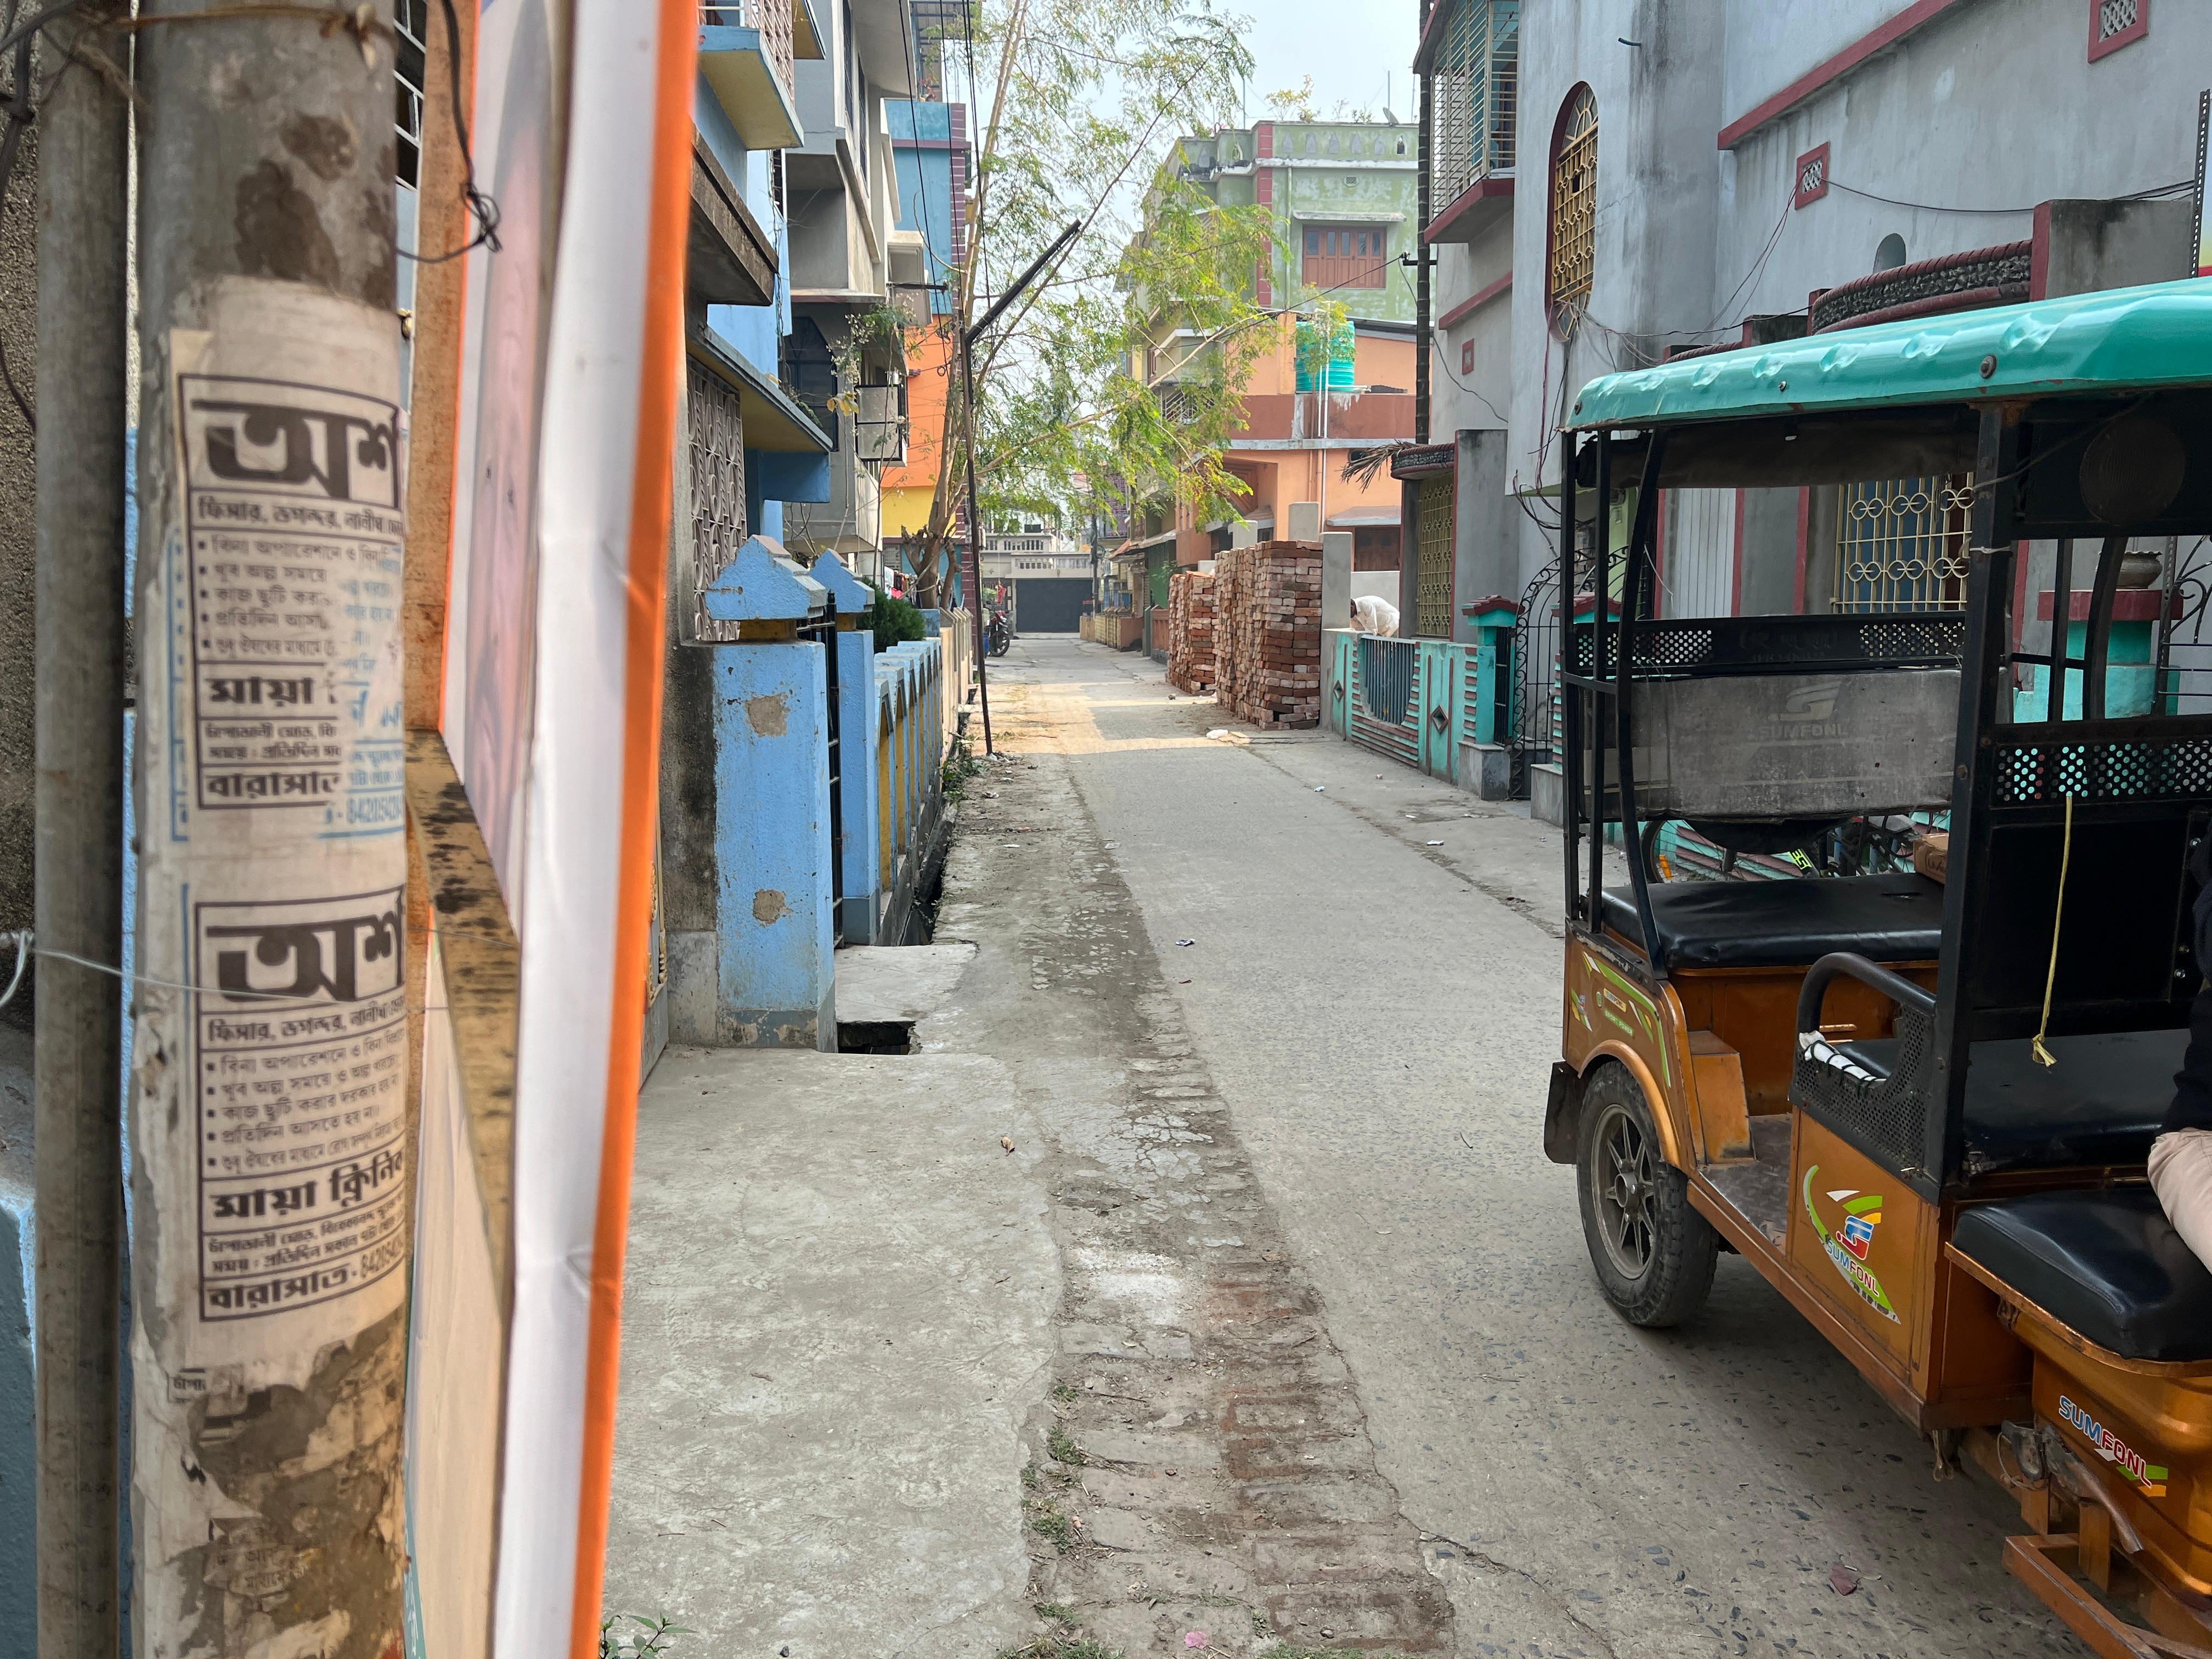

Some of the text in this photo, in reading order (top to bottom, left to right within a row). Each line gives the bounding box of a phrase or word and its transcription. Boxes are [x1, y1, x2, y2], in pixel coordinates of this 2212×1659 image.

[210, 1180, 317, 1218] মায়া
[210, 1262, 352, 1308] বারাসাত
[1825, 1240, 1880, 1297] SUMFONL
[2059, 1395, 2152, 1488] SUMFONL
